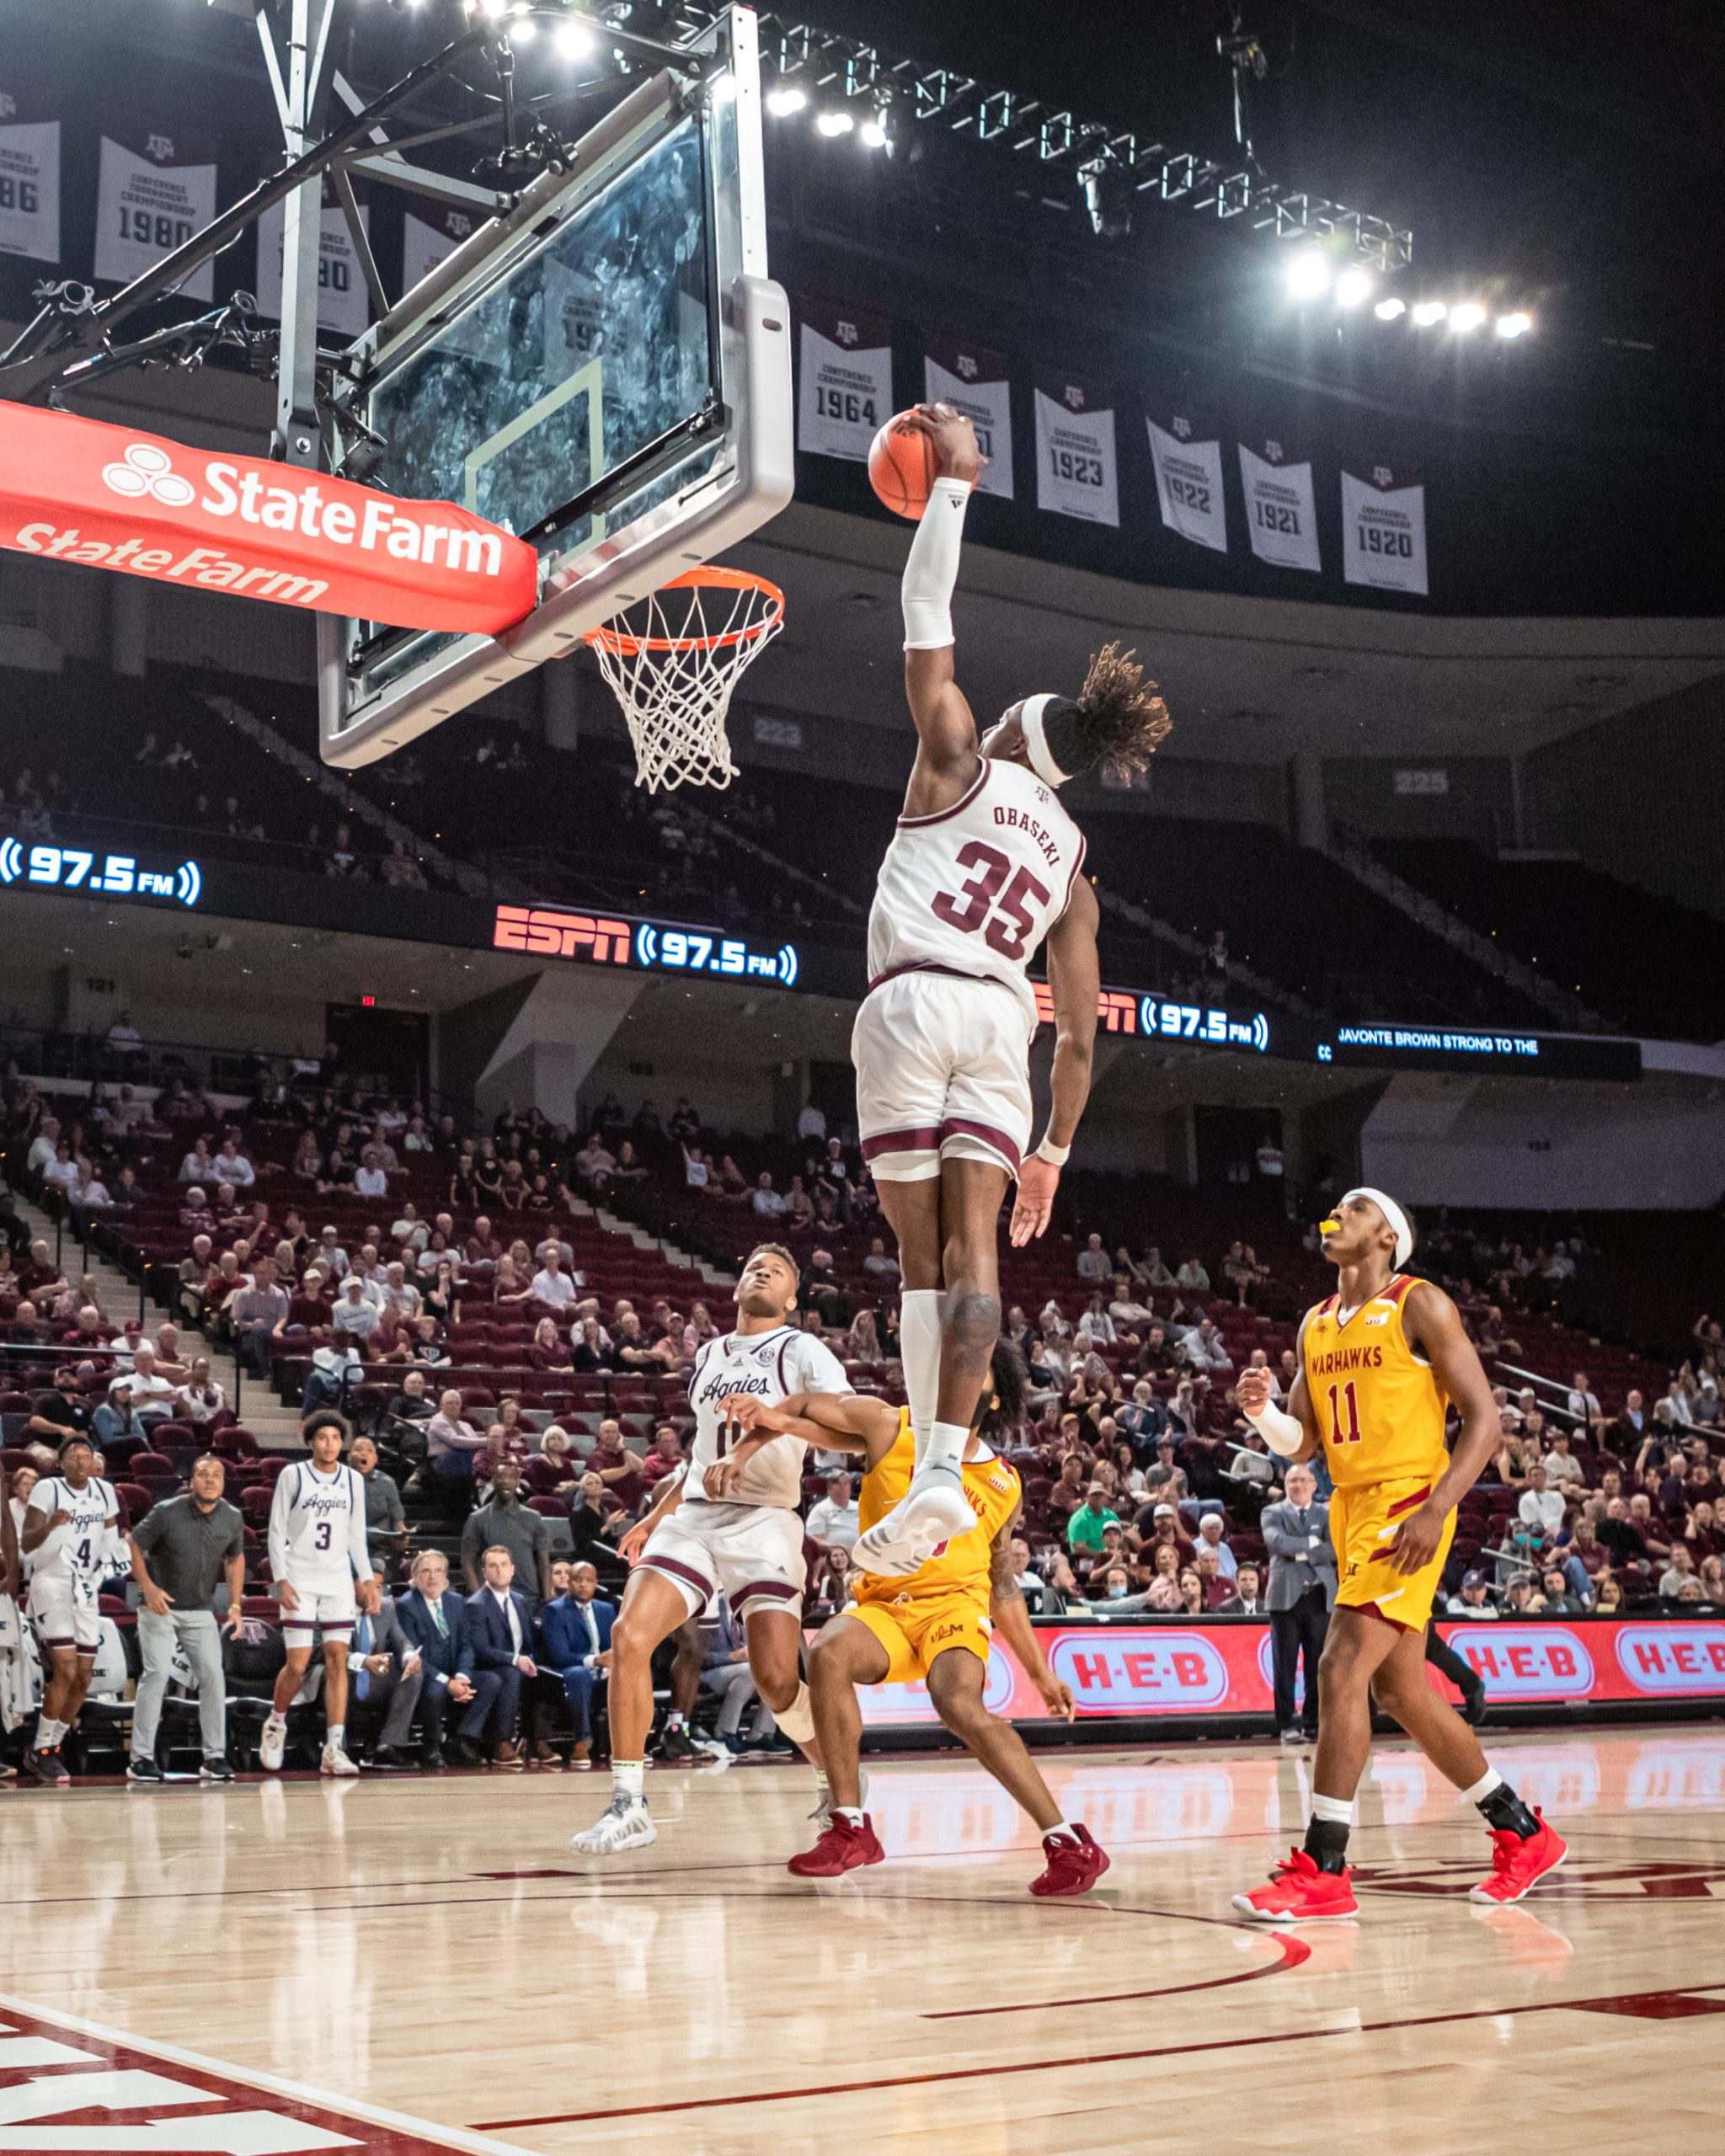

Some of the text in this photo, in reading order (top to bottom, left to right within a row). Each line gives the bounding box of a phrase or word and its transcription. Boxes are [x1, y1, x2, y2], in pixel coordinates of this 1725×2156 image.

[816, 386, 878, 427] 1964
[1050, 448, 1103, 487] 1923
[1164, 473, 1211, 515] 1922
[1256, 500, 1302, 536] 1921
[1359, 525, 1413, 559] 1920
[993, 806, 1060, 868] OBASEKI
[29, 845, 175, 896] 97.5 FM
[931, 841, 1051, 961] 35
[494, 905, 777, 978] ESPN 97.5 FM
[1161, 1004, 1227, 1043] 97.5
[1229, 1023, 1252, 1043] FM
[1338, 1027, 1540, 1056] JAVONTE BROWN STRONG TO THE
[1311, 1346, 1383, 1377] WARHAWKS
[1327, 1379, 1361, 1445] 11
[302, 1493, 347, 1518] Aggies
[77, 1539, 91, 1568] 4
[315, 1522, 332, 1550] 3
